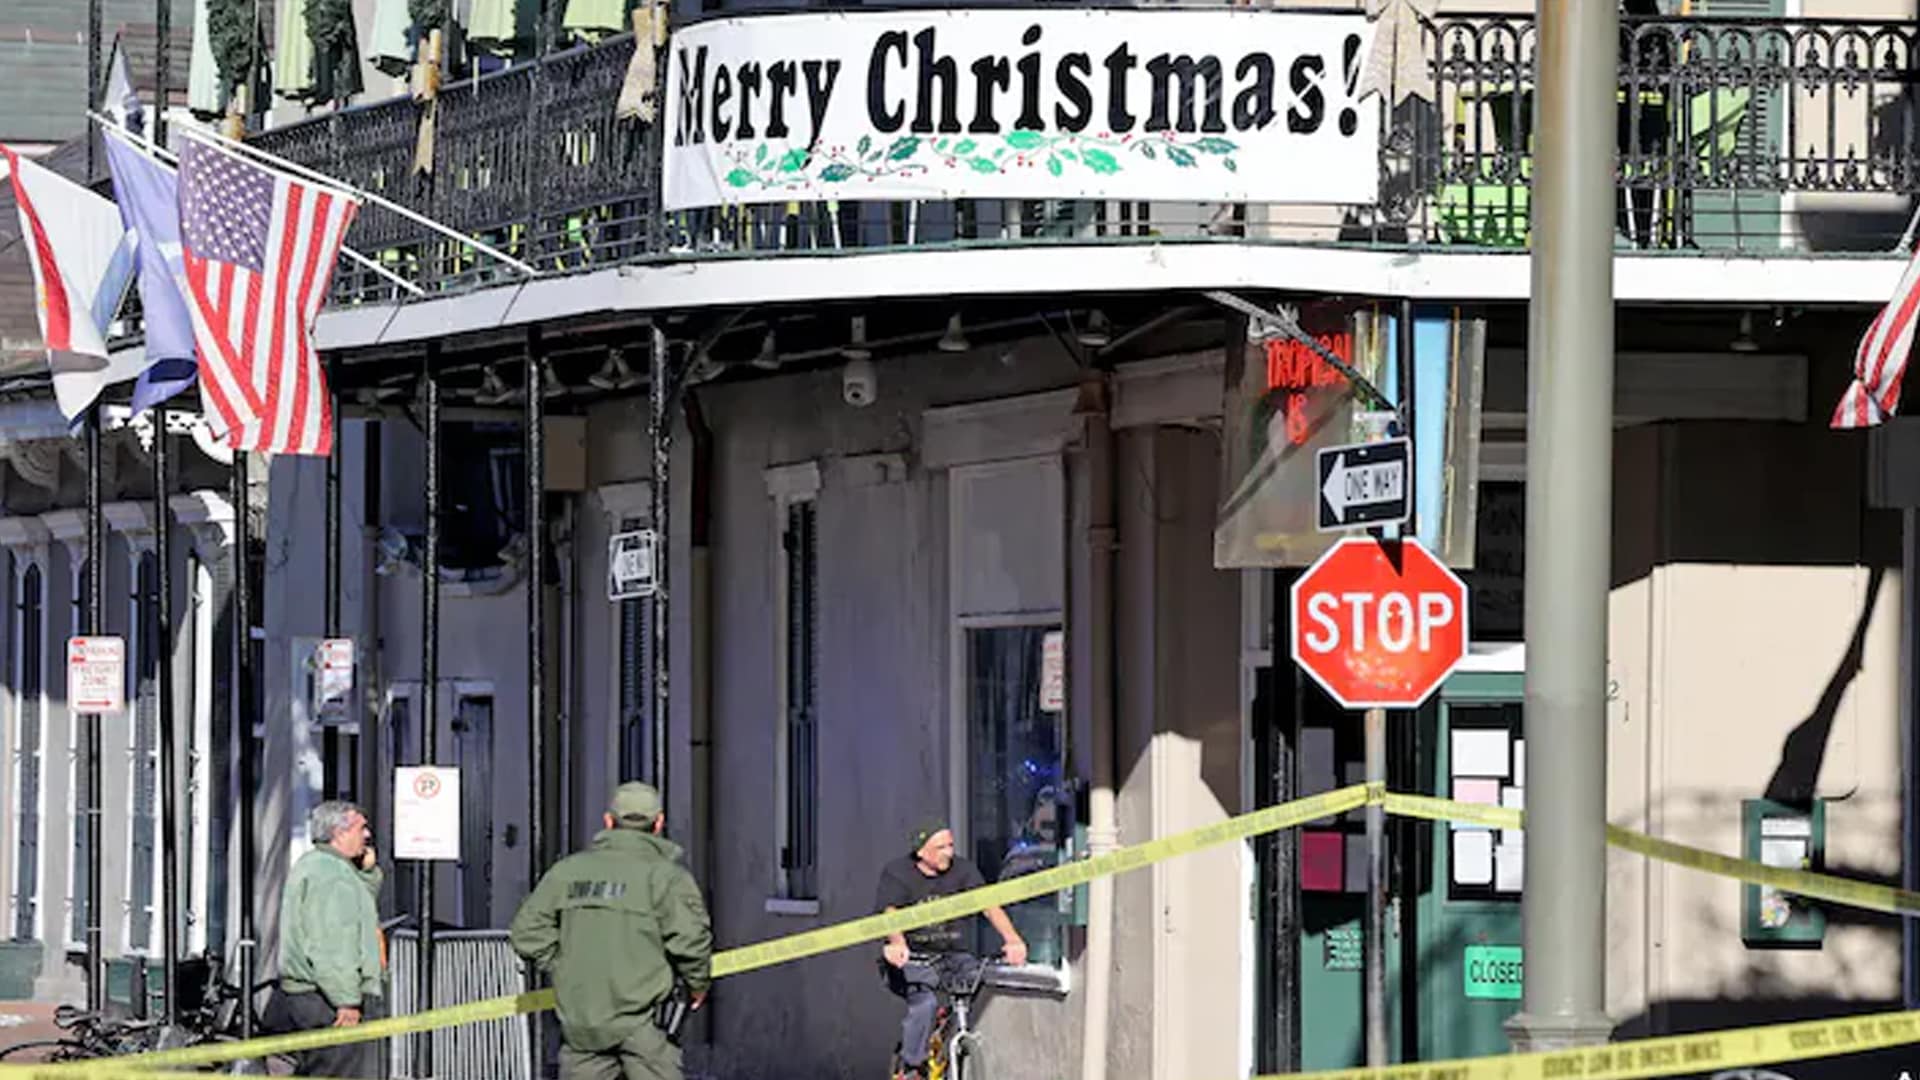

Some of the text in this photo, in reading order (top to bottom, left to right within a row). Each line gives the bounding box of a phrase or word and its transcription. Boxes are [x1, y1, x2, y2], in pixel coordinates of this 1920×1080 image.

[674, 24, 1362, 170] Merry Christmas!
[1344, 464, 1400, 500] ONE WAY
[1305, 591, 1454, 653] STOP
